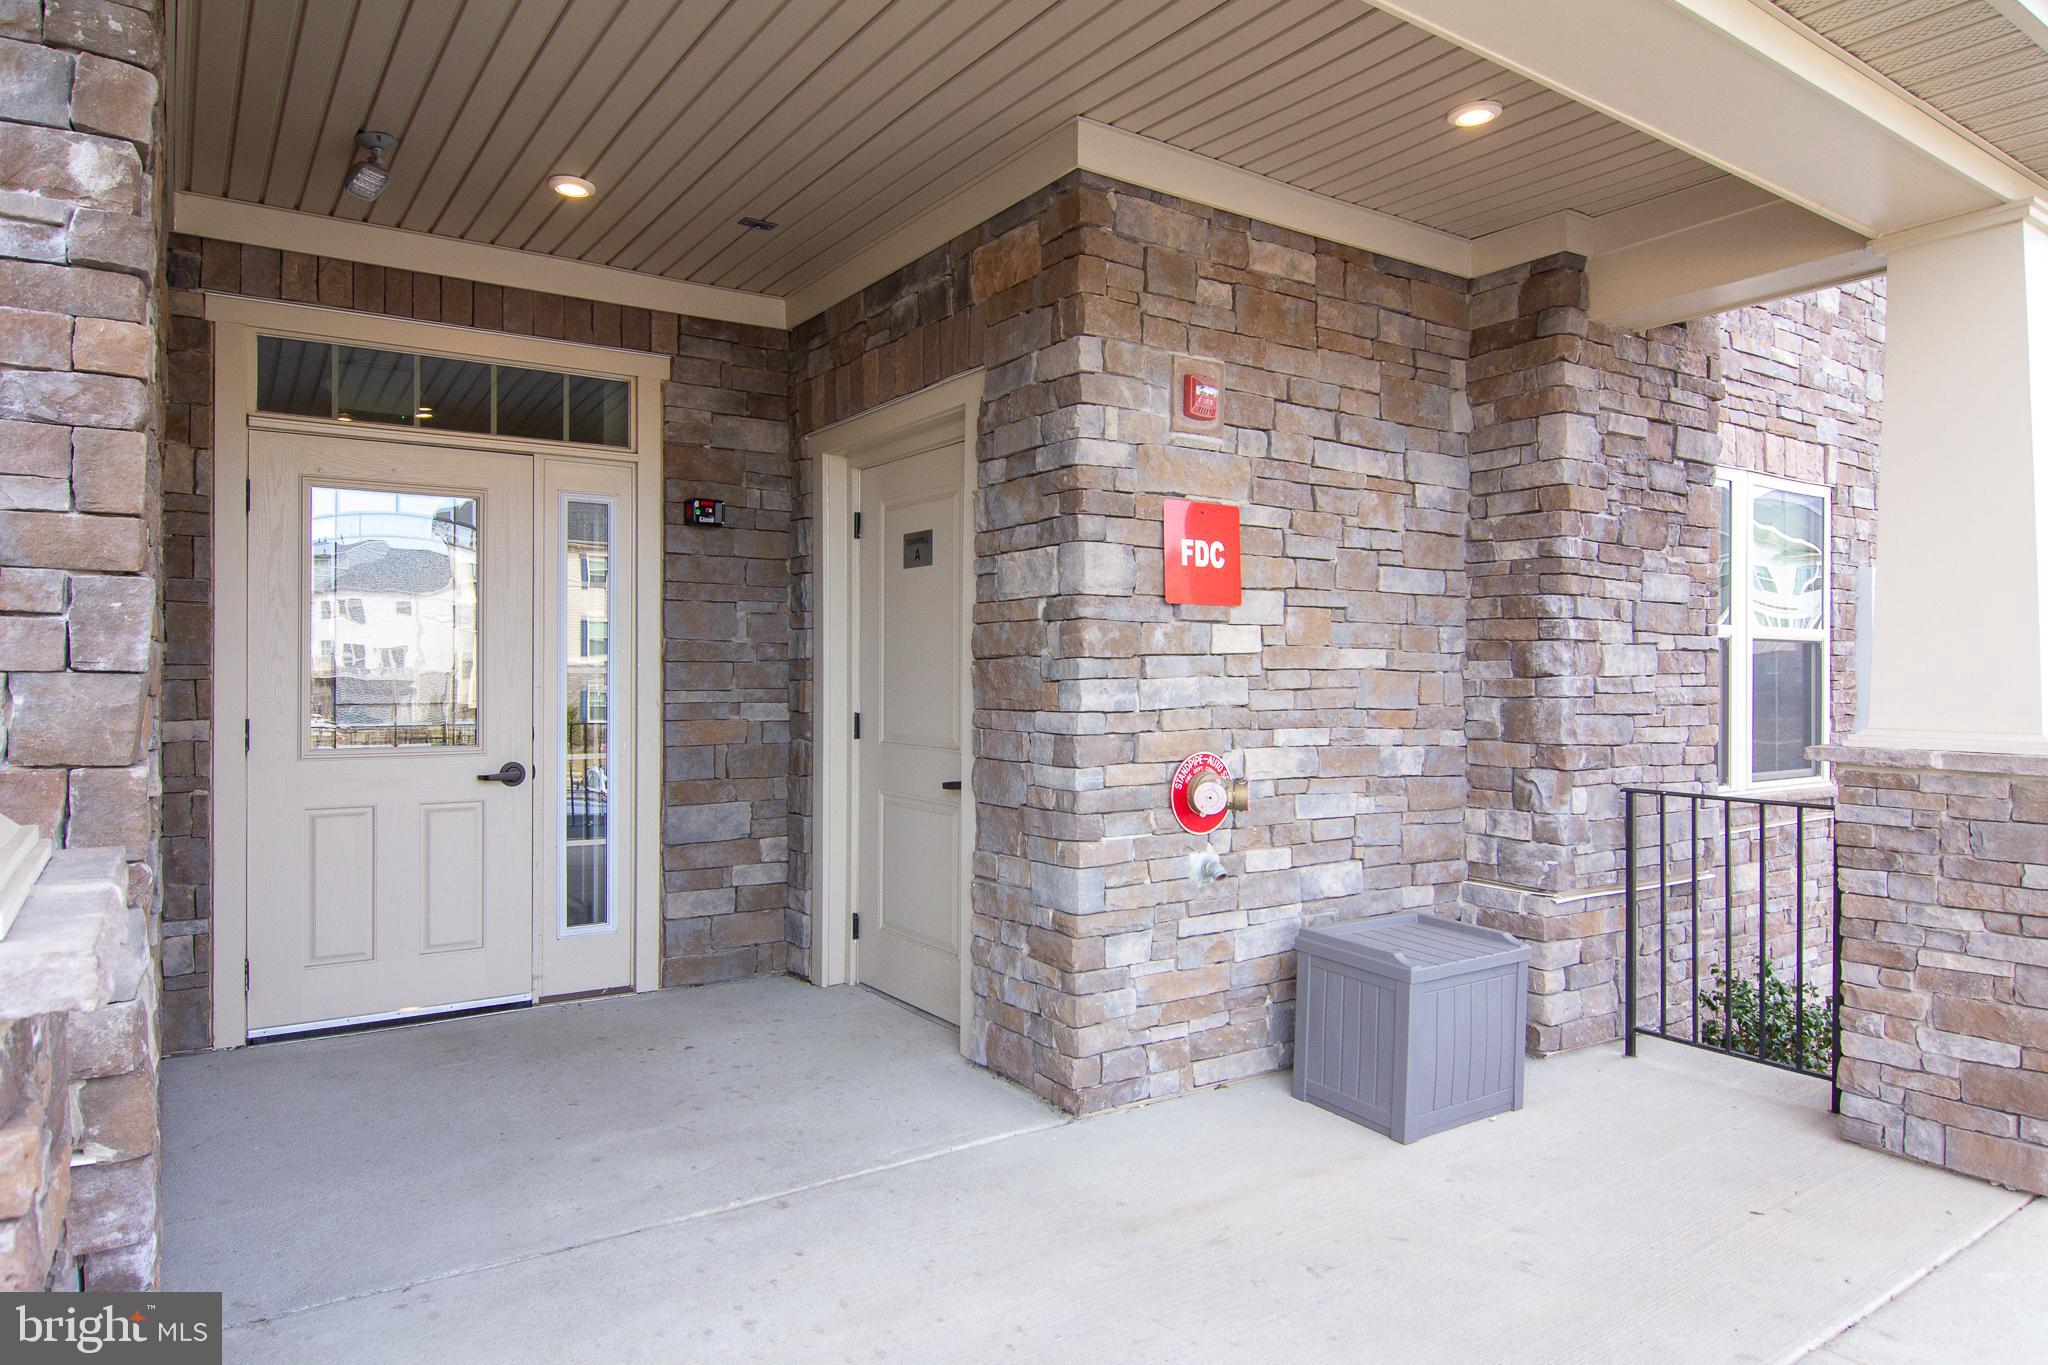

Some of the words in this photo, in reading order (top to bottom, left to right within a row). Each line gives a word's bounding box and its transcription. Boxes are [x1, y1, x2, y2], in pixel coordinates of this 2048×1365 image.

[1199, 397, 1214, 406] FIRE
[915, 549, 921, 561] A
[1181, 538, 1226, 569] FDC
